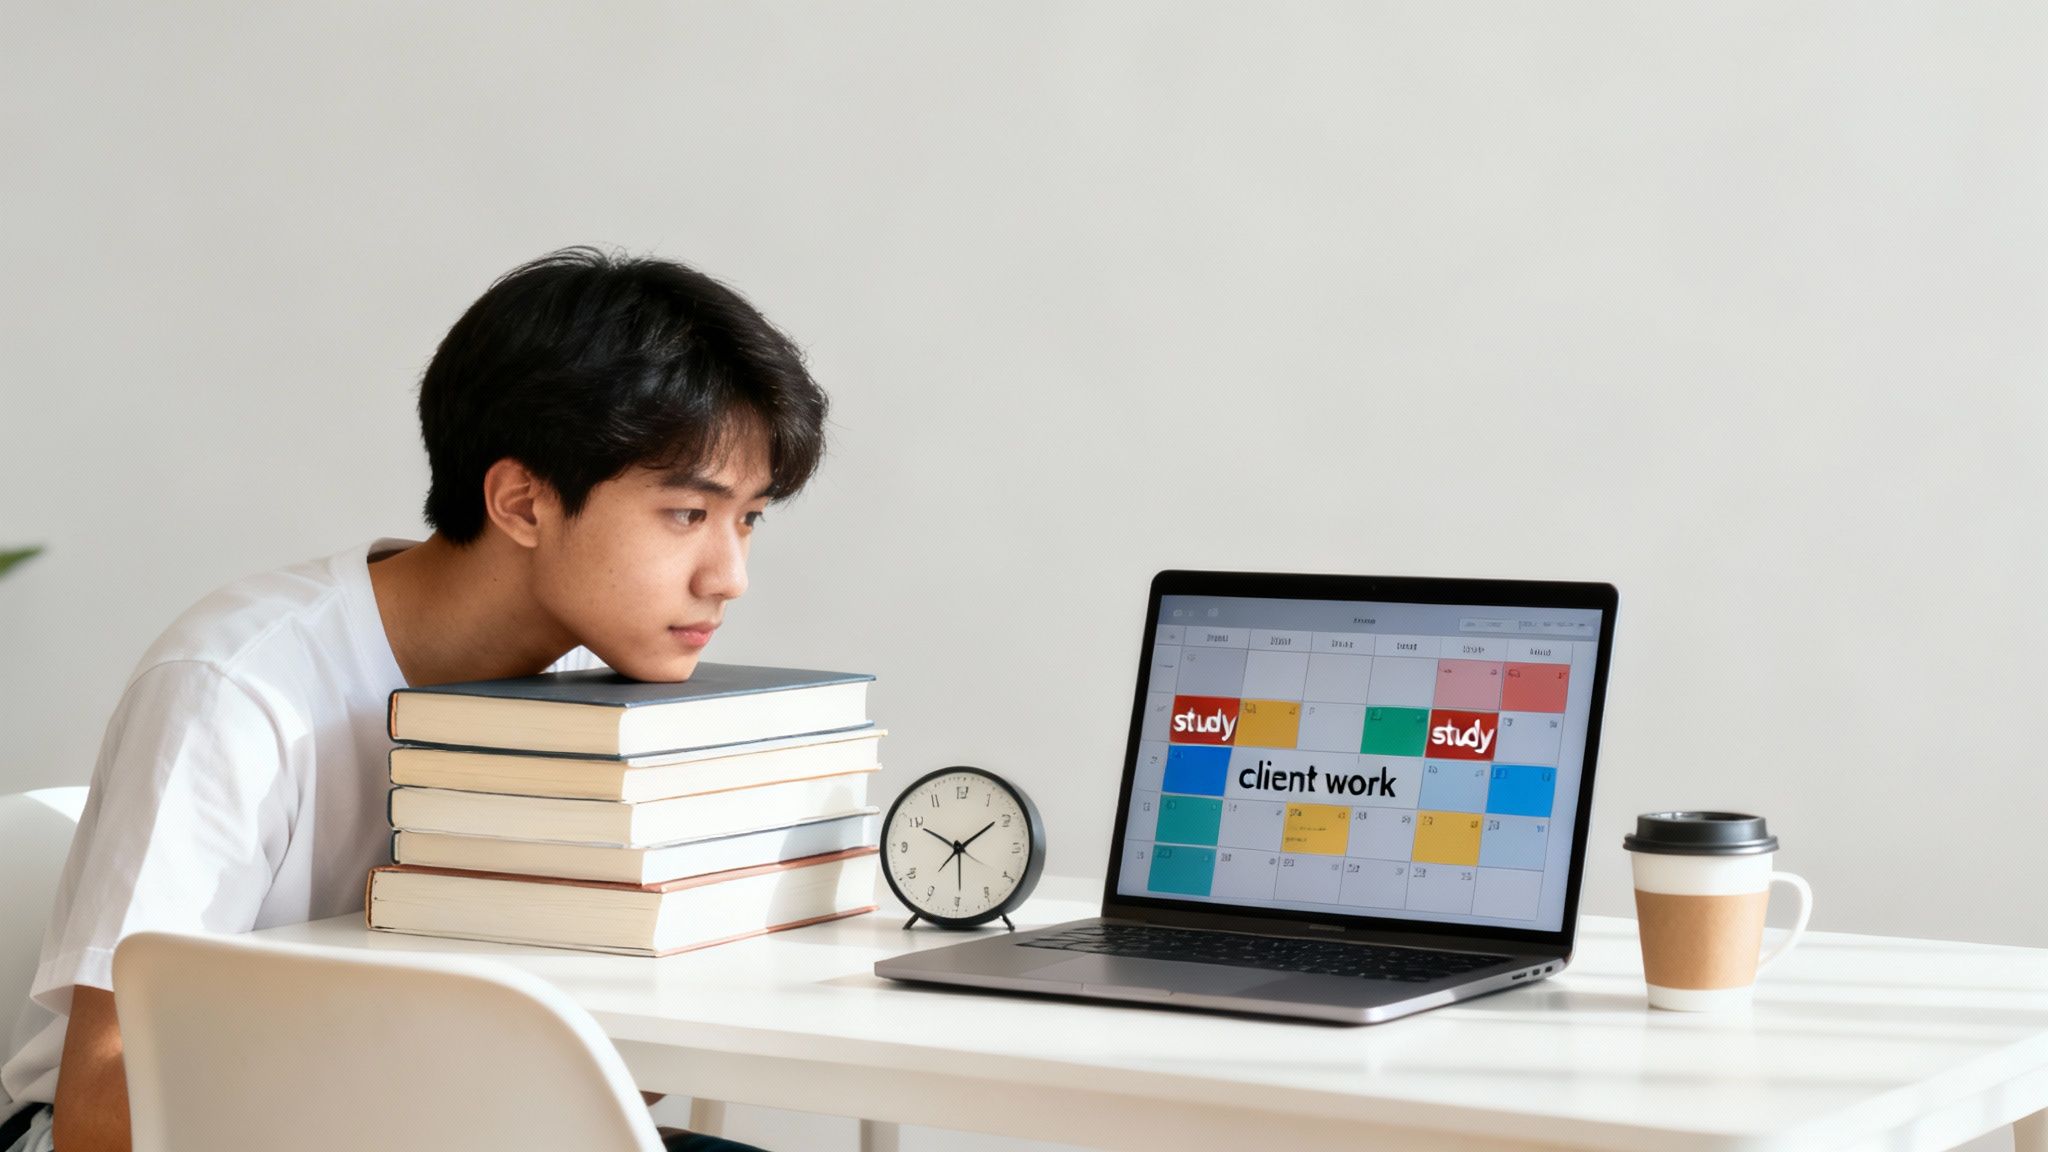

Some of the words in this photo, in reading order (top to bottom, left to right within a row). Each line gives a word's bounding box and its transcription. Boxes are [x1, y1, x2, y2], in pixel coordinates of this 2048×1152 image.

[1173, 707, 1237, 741] study
[1431, 718, 1495, 754] study
[1239, 760, 1317, 792] client
[1325, 766, 1397, 798] work
